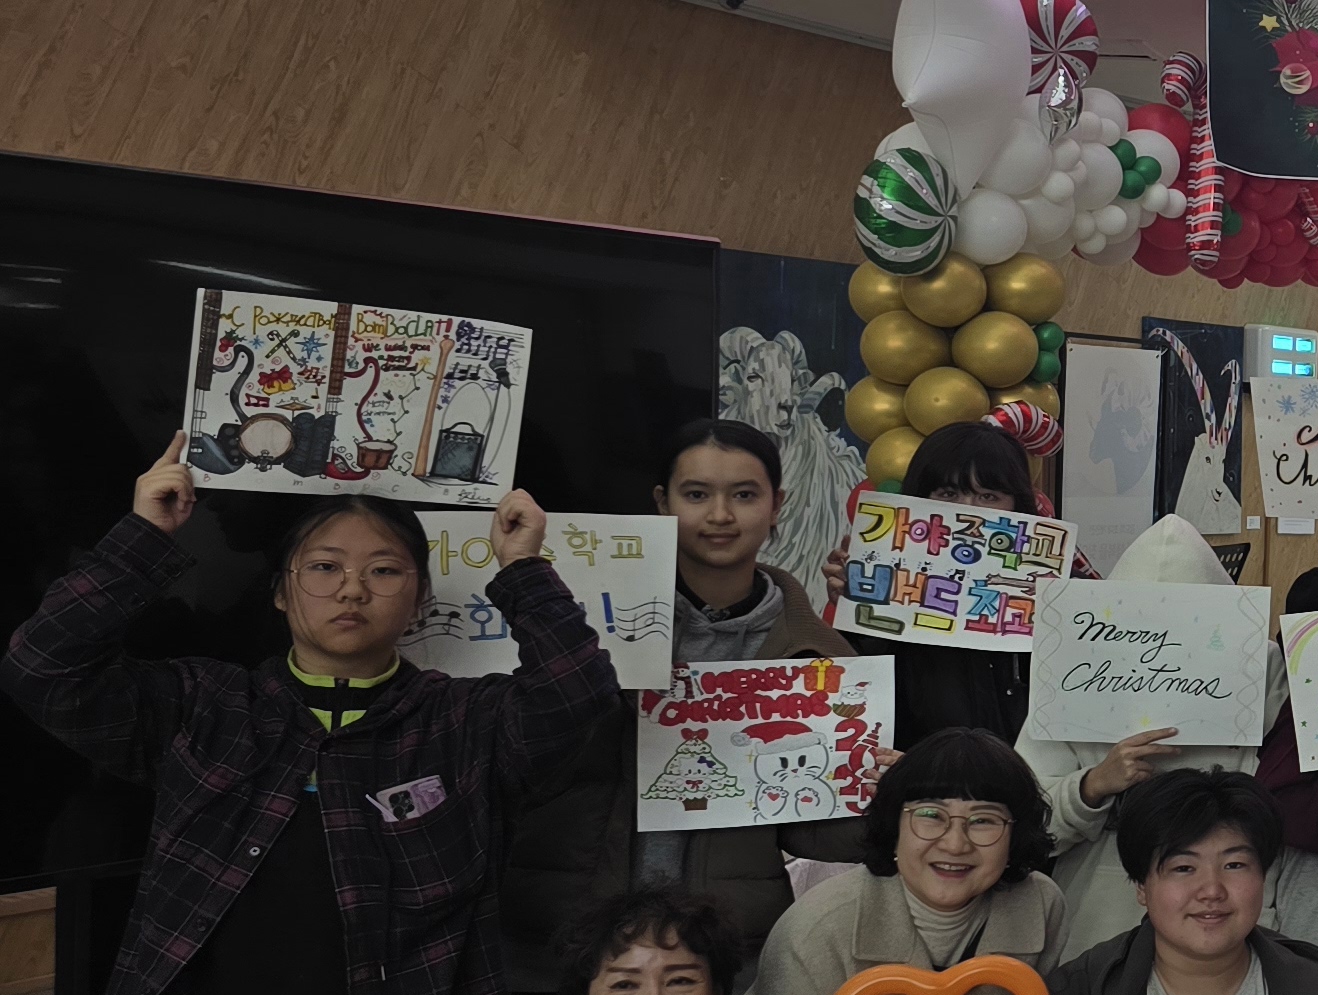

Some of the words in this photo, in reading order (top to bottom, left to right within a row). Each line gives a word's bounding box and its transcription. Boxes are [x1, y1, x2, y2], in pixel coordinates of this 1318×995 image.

[858, 502, 1068, 575] 가야중학교
[846, 559, 963, 636] 밴드
[1073, 611, 1183, 664] Merry
[701, 665, 801, 695] MERRY
[1061, 660, 1233, 699] Christmas
[658, 691, 833, 727] CHRISTMAS
